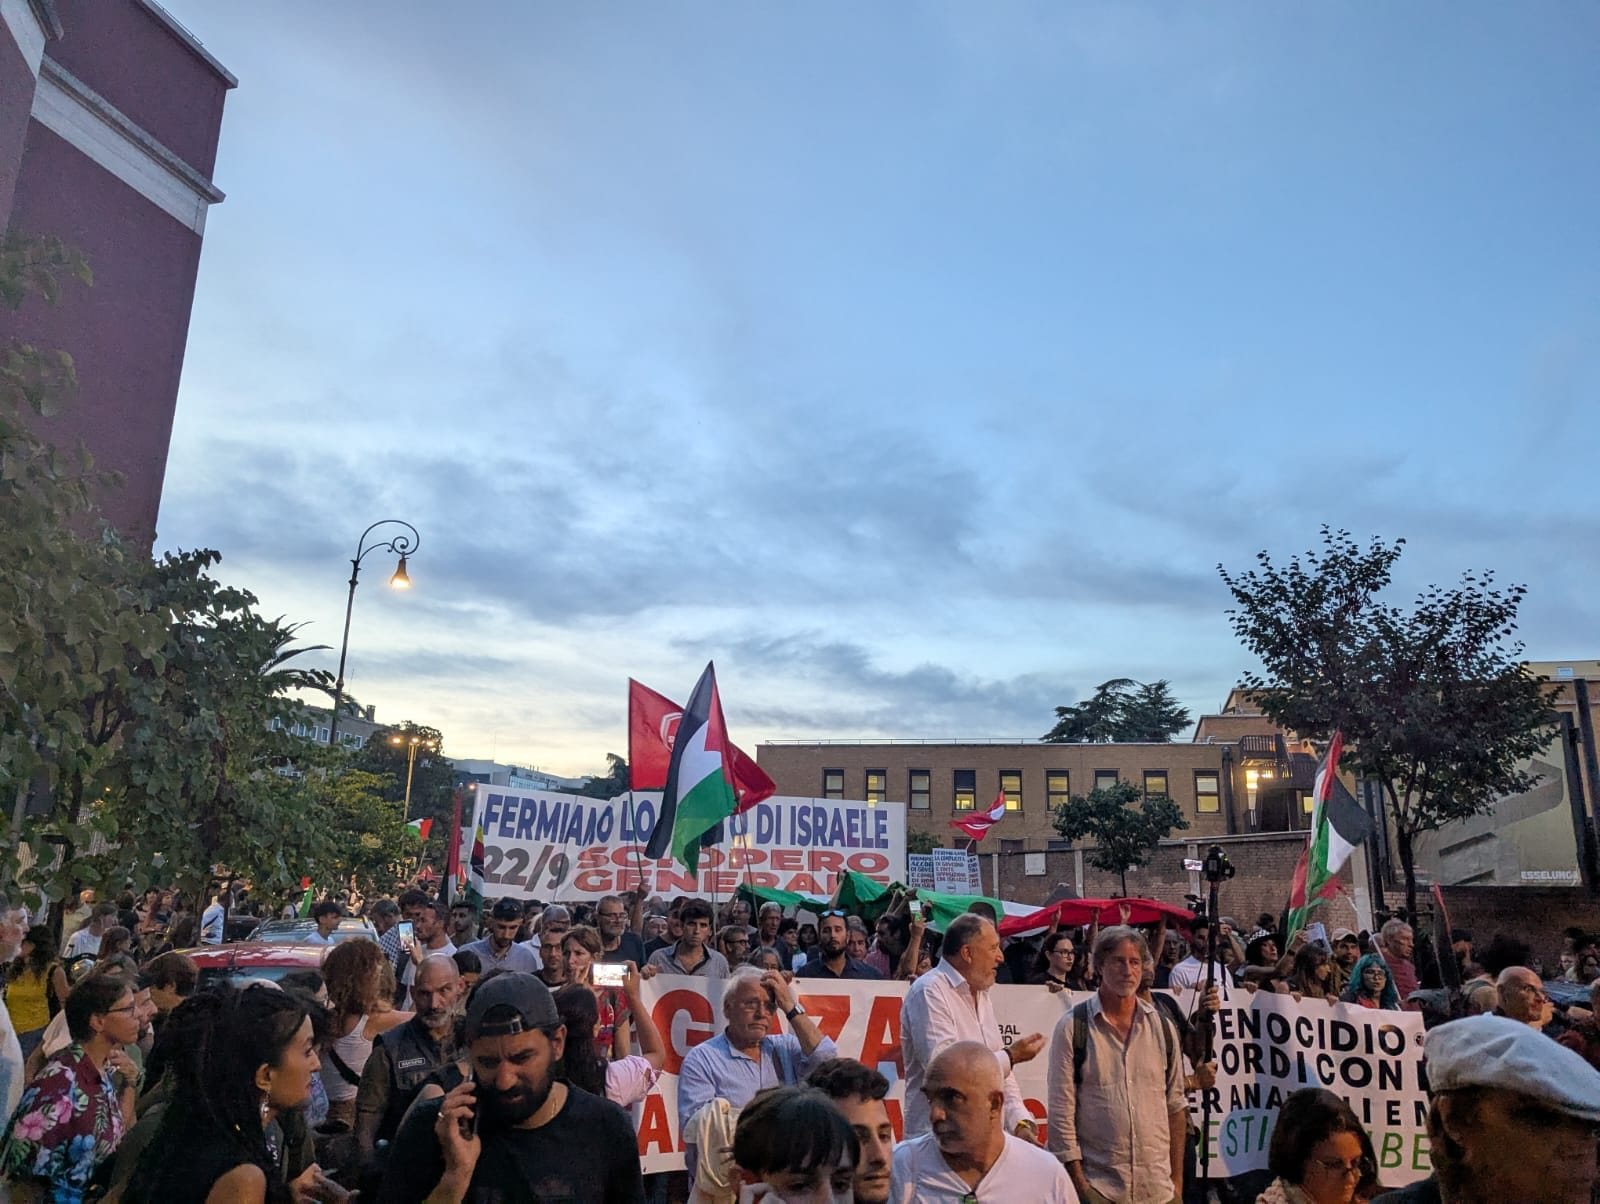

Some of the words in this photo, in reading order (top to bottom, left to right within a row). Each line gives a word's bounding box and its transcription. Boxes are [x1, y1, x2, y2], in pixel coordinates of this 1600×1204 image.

[620, 799, 656, 842] LO
[756, 804, 781, 845] DI
[790, 805, 889, 849] ISRAELE
[484, 845, 570, 892] 22/9
[574, 869, 890, 897] GENERA
[652, 989, 906, 1080] GZA
[1212, 1008, 1406, 1057] ENOCIDIO
[1212, 1043, 1308, 1084] ORDI
[1316, 1053, 1403, 1091] CON
